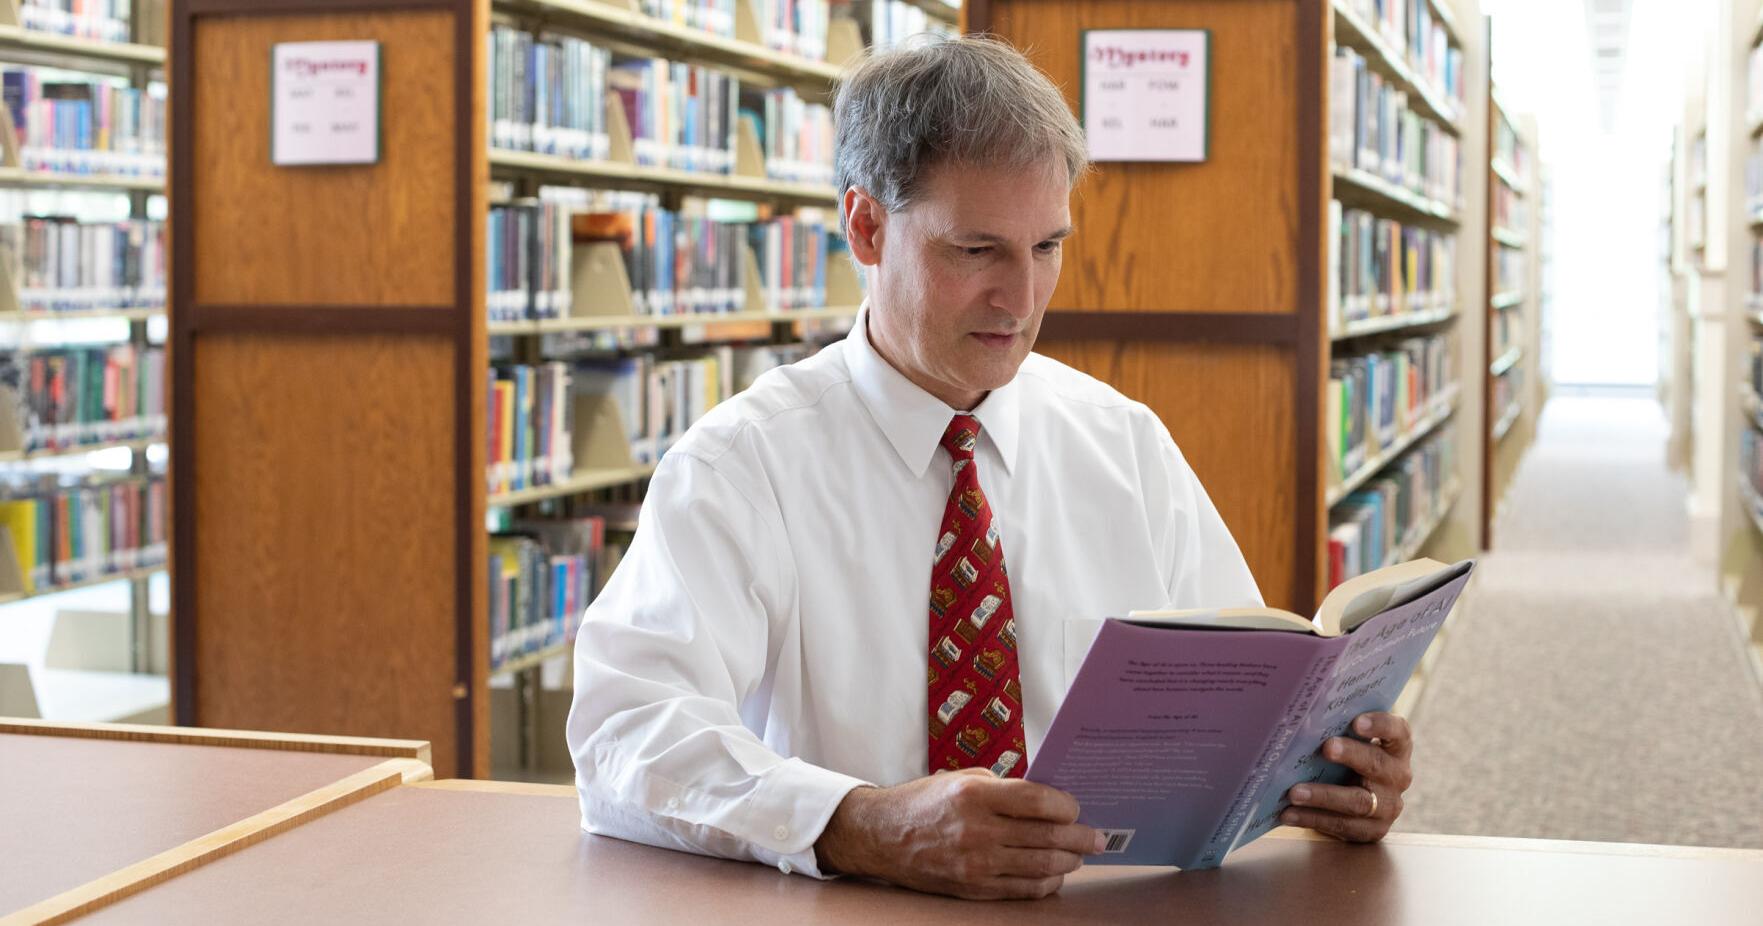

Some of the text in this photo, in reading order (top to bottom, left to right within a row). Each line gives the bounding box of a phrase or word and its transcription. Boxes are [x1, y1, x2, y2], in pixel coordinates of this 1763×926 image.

[1376, 619, 1407, 641] Age
[1410, 602, 1433, 624] of
[1432, 595, 1454, 614] AI
[1305, 676, 1323, 699] Age
[1337, 665, 1379, 692] Henry
[1298, 701, 1308, 711] of
[1324, 676, 1387, 714] Kissinger
[1288, 715, 1302, 727] AI
[1275, 728, 1293, 751] And
[1262, 752, 1280, 772] Our
